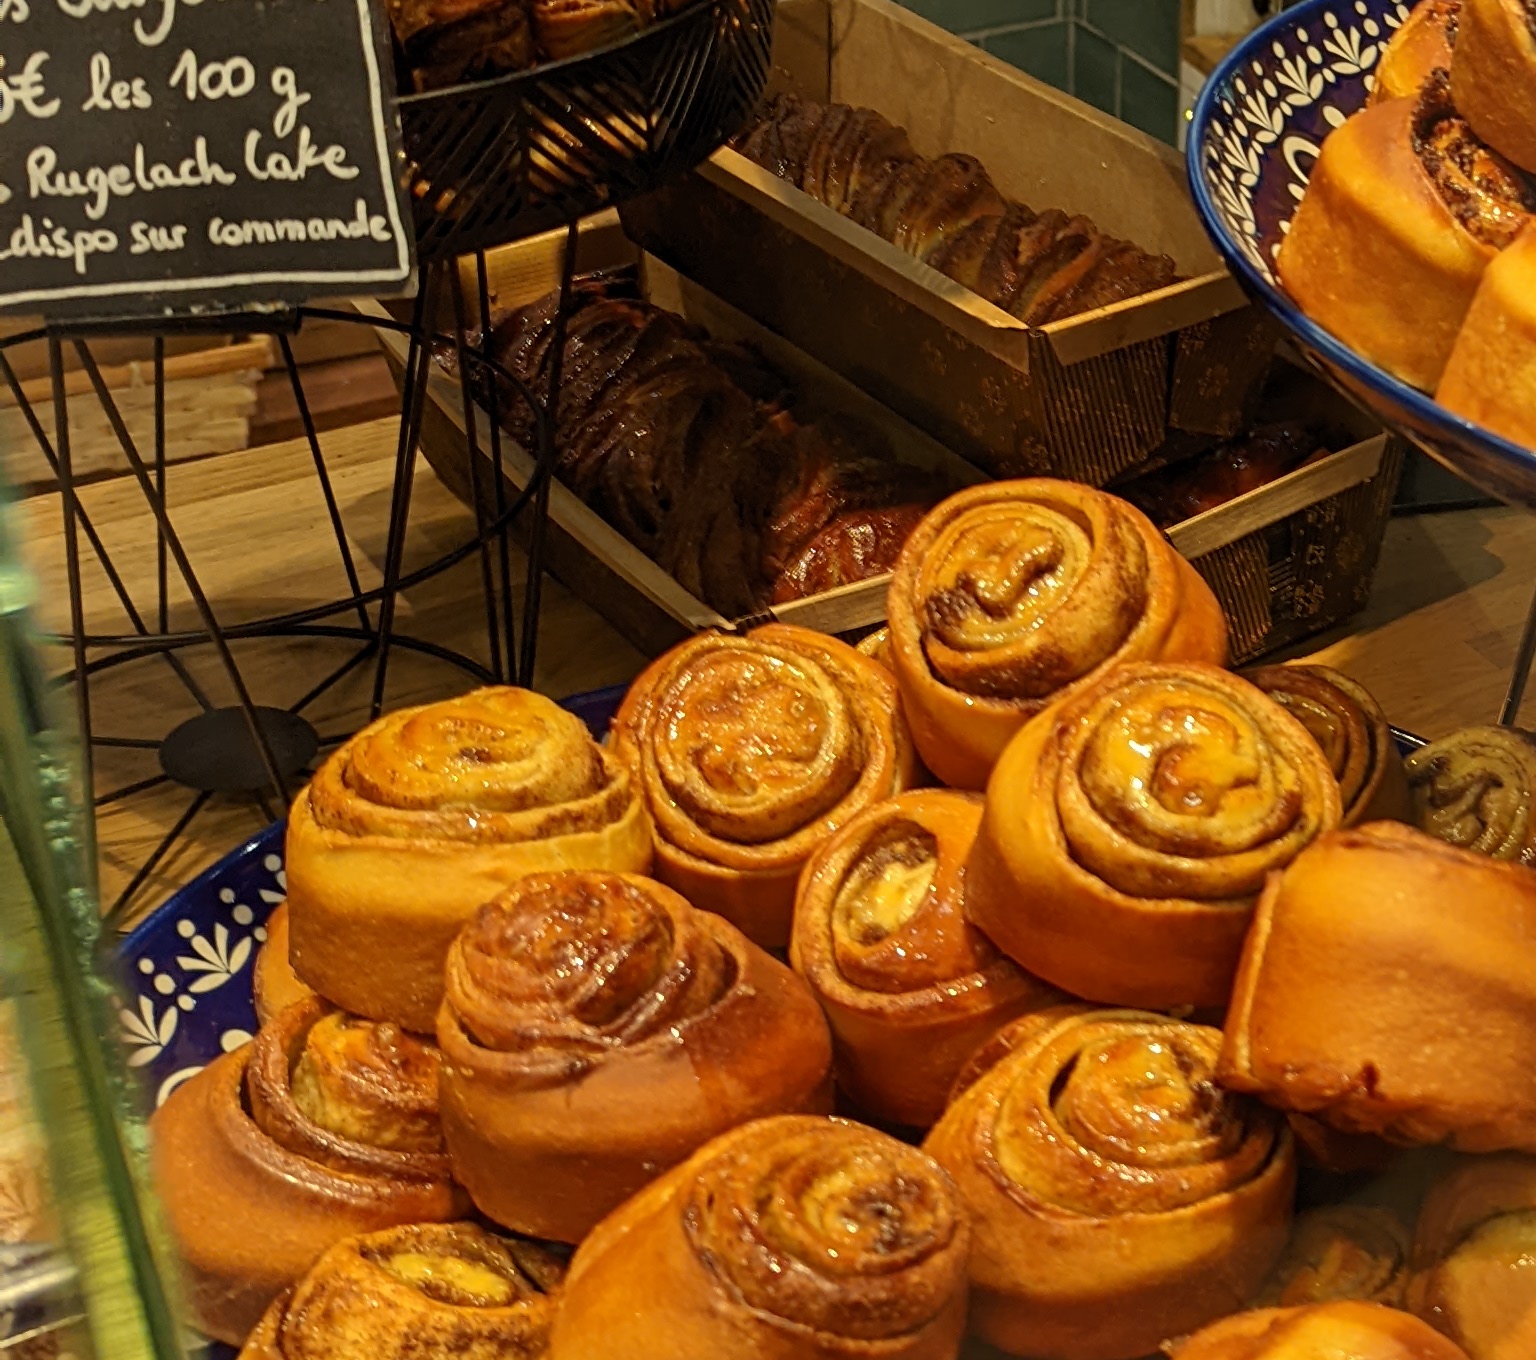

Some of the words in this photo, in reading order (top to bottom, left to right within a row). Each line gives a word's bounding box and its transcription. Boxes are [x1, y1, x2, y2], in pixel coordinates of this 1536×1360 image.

[82, 52, 152, 111] les
[169, 48, 256, 101] 100
[271, 66, 311, 138] g
[27, 135, 237, 220] Rugelach
[130, 220, 188, 255] sur
[208, 198, 392, 247] commande
